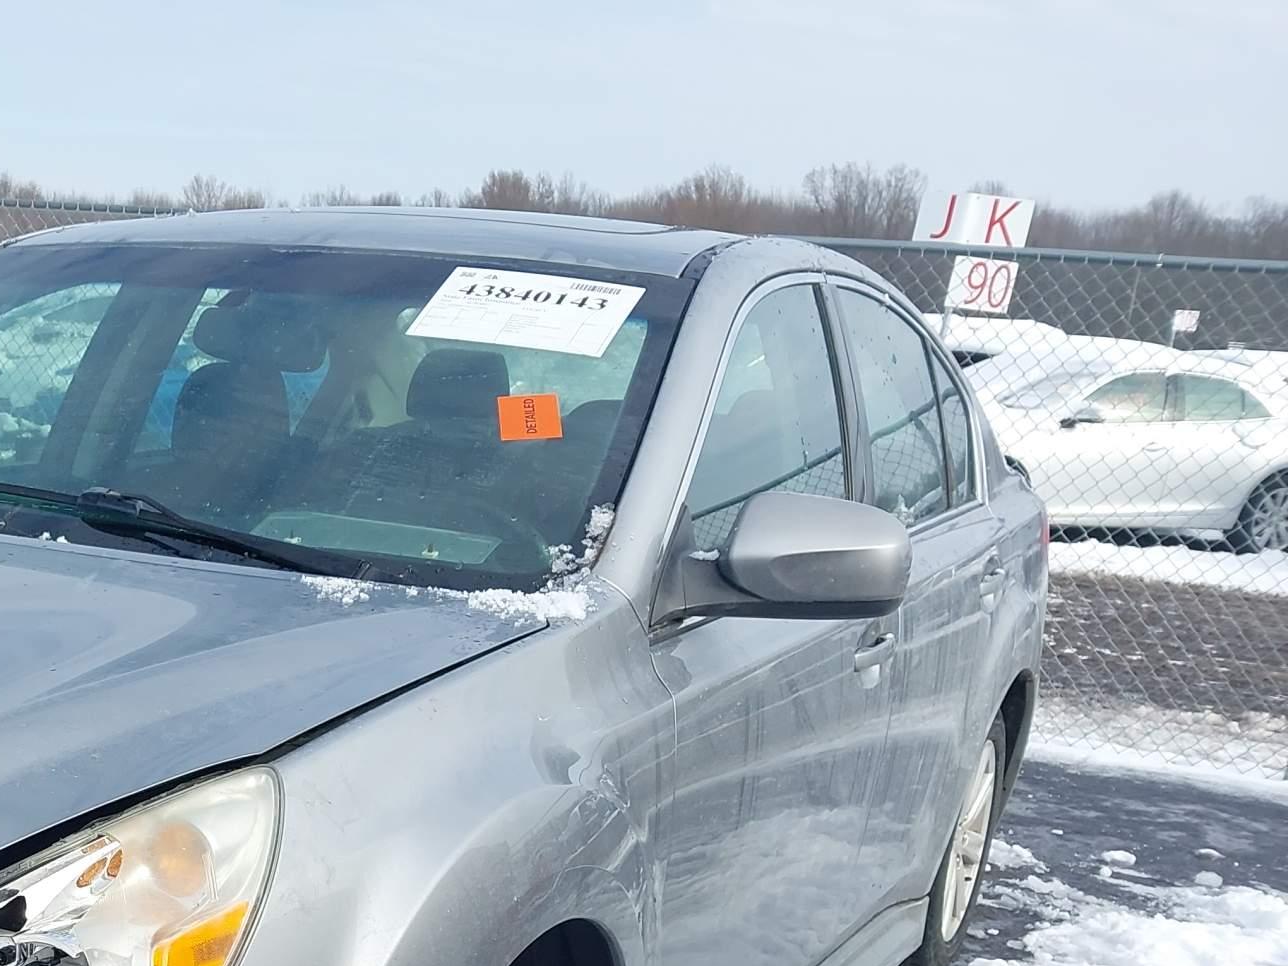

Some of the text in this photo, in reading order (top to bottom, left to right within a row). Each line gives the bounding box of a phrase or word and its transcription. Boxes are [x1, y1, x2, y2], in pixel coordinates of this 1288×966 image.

[929, 194, 1022, 246] J K
[458, 283, 609, 311] 43840143
[964, 261, 1011, 308] 90
[524, 398, 538, 434] DETAILED
